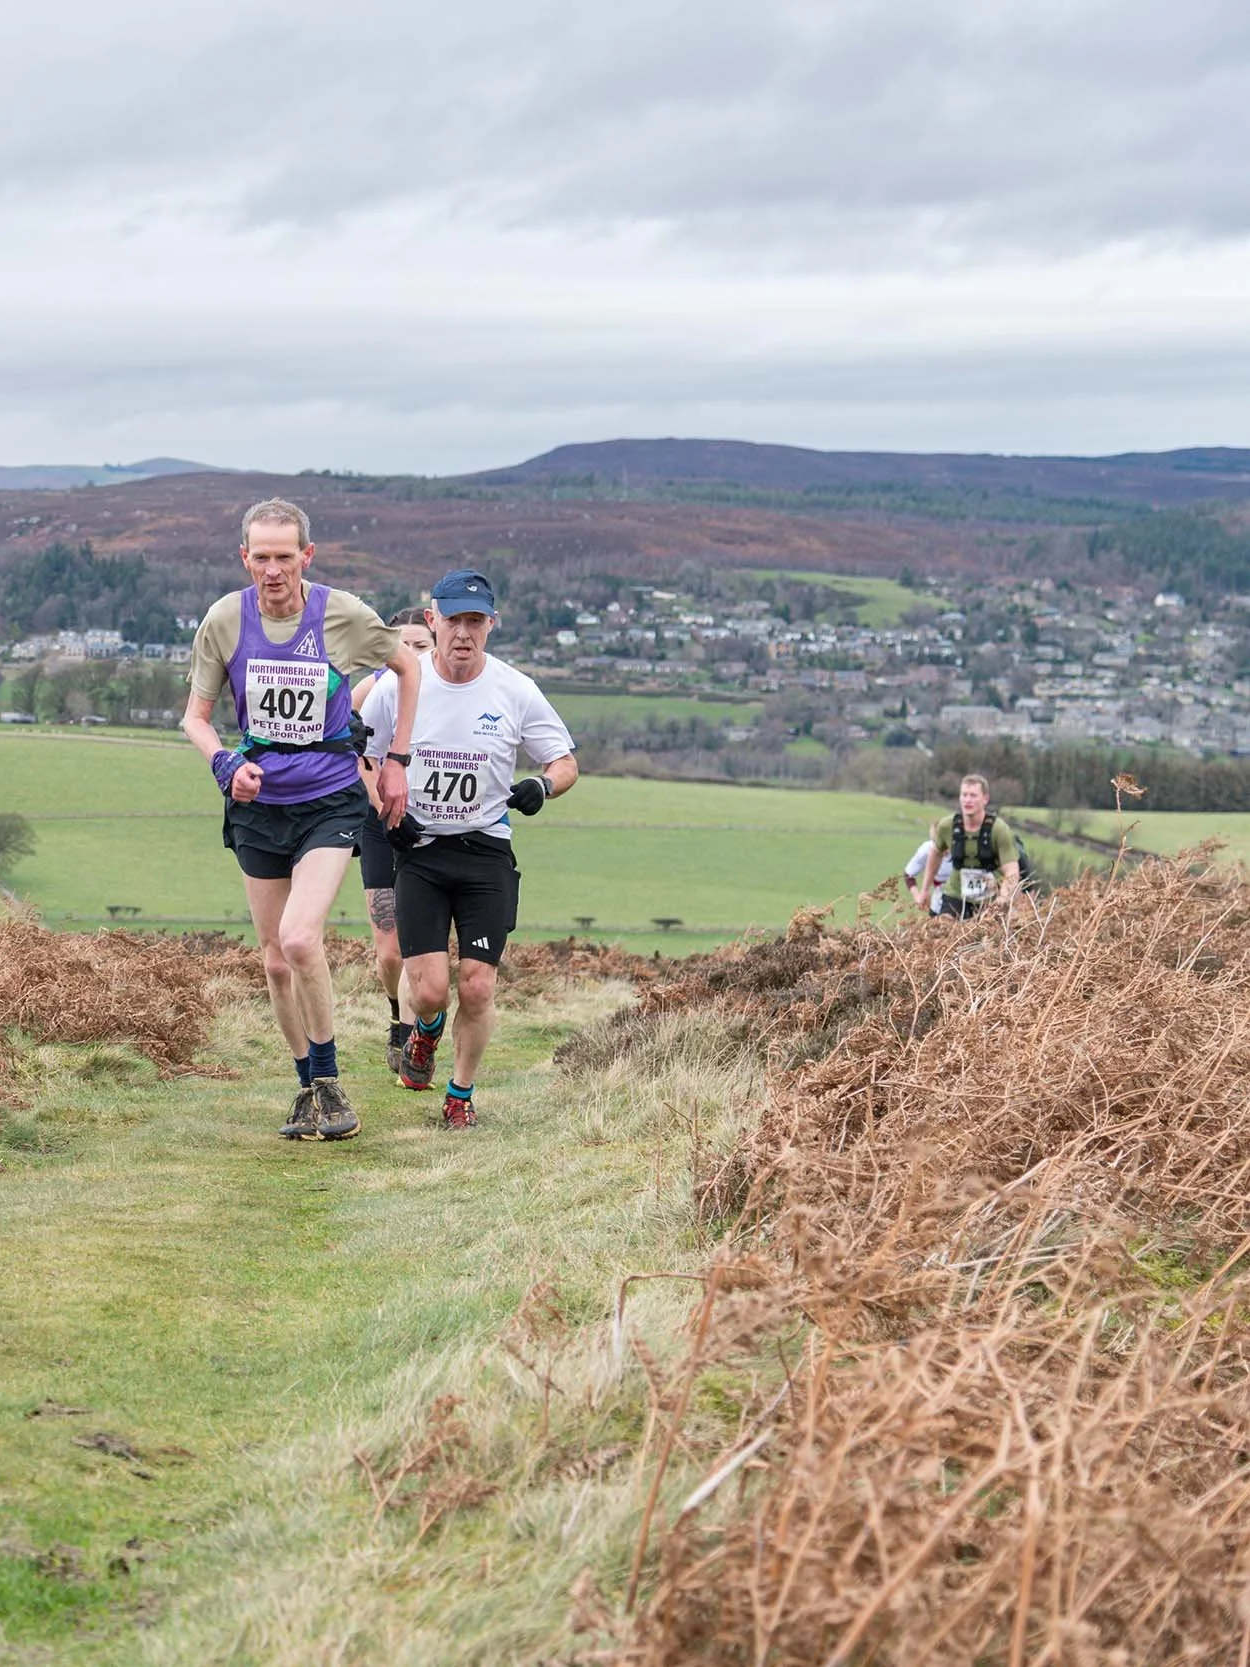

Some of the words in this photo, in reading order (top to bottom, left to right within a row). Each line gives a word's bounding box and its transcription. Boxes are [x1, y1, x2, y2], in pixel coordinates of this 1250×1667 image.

[249, 664, 326, 677] NORTHUMBERLAND
[257, 675, 274, 685] FELL
[277, 676, 316, 687] RUNNERS
[259, 688, 315, 722] 402
[252, 718, 281, 731] PETE
[284, 723, 322, 733] BLAND
[481, 723, 498, 731] 2025
[269, 730, 304, 740] SPORTS
[416, 749, 488, 761] NORTHUMBERLAND
[423, 759, 441, 768] FELL
[442, 761, 479, 771] RUNNERS
[423, 771, 477, 803] 470
[415, 801, 443, 813] PETE
[446, 803, 481, 814] BLAND
